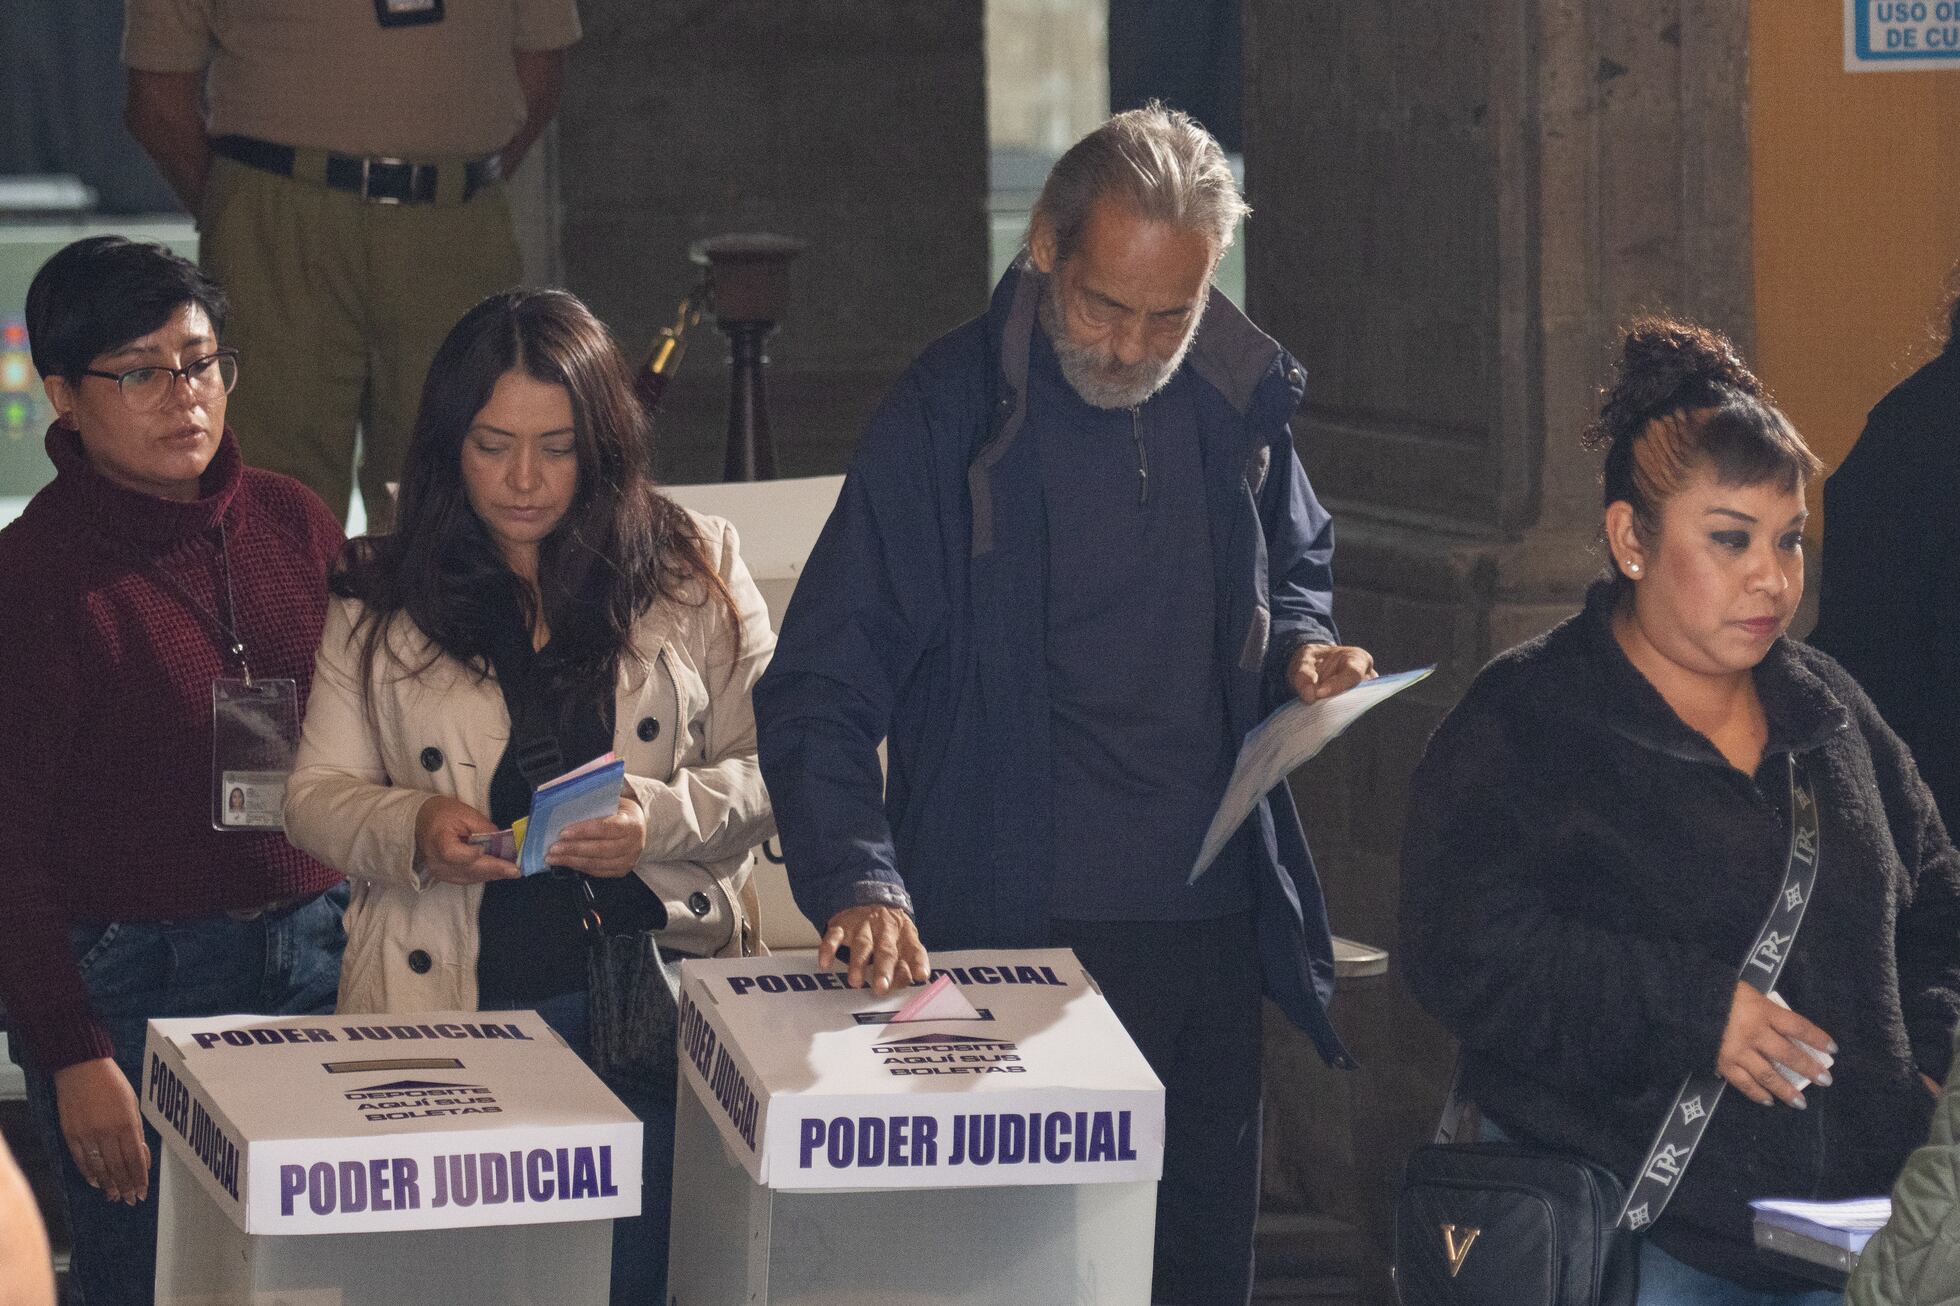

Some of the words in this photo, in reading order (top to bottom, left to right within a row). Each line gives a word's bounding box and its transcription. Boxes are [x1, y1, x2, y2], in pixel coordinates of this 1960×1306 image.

[1877, 2, 1928, 23] USO
[1886, 27, 1918, 49] DE
[191, 1027, 338, 1050] PODER
[341, 1023, 535, 1041] JUDICIAL
[871, 1043, 1018, 1054] DEPOSITE
[882, 1053, 956, 1065] AQUÍ
[959, 1054, 1022, 1063] SUS
[679, 989, 717, 1083] PODER
[710, 1041, 760, 1153] JUDICIAL
[889, 1065, 1027, 1076] BOLETAS
[343, 1087, 493, 1101] DEPOSITE
[356, 1098, 431, 1111] AQUÍ
[433, 1096, 498, 1106] SUS
[364, 1106, 504, 1122] BOLETAS
[149, 1051, 190, 1141] PODER
[189, 1098, 240, 1203] JUDICIAL
[800, 1115, 939, 1169] PODER
[948, 1110, 1137, 1167] JUDICIAL
[279, 1156, 421, 1217] PODER
[431, 1145, 619, 1209] JUDICIAL
[1441, 1222, 1482, 1278] V
